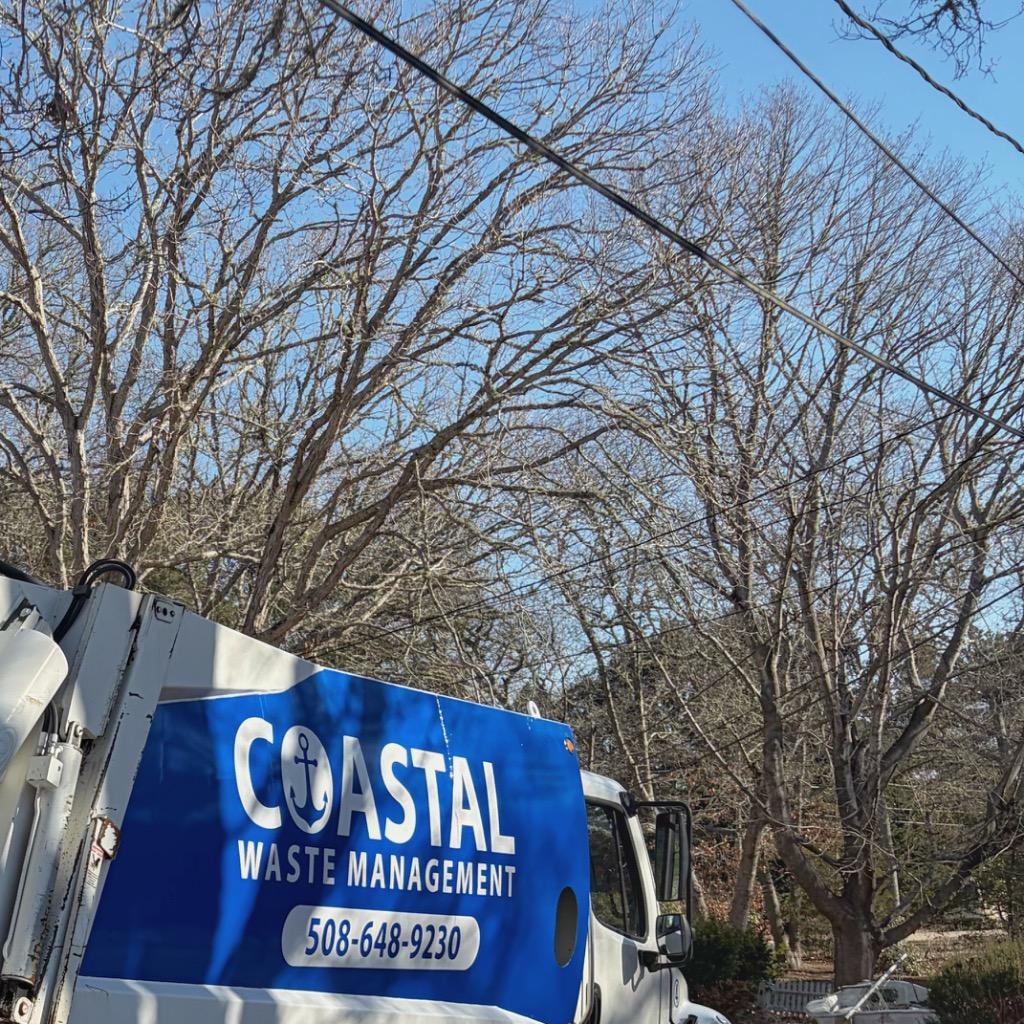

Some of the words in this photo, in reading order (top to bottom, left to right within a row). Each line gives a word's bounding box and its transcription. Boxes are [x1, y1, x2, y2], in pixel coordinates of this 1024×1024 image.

[234, 717, 515, 855] COASTAL
[238, 840, 335, 885] WASTE
[347, 850, 516, 897] MANAGEMENT
[305, 917, 461, 960] 508-648-9230
